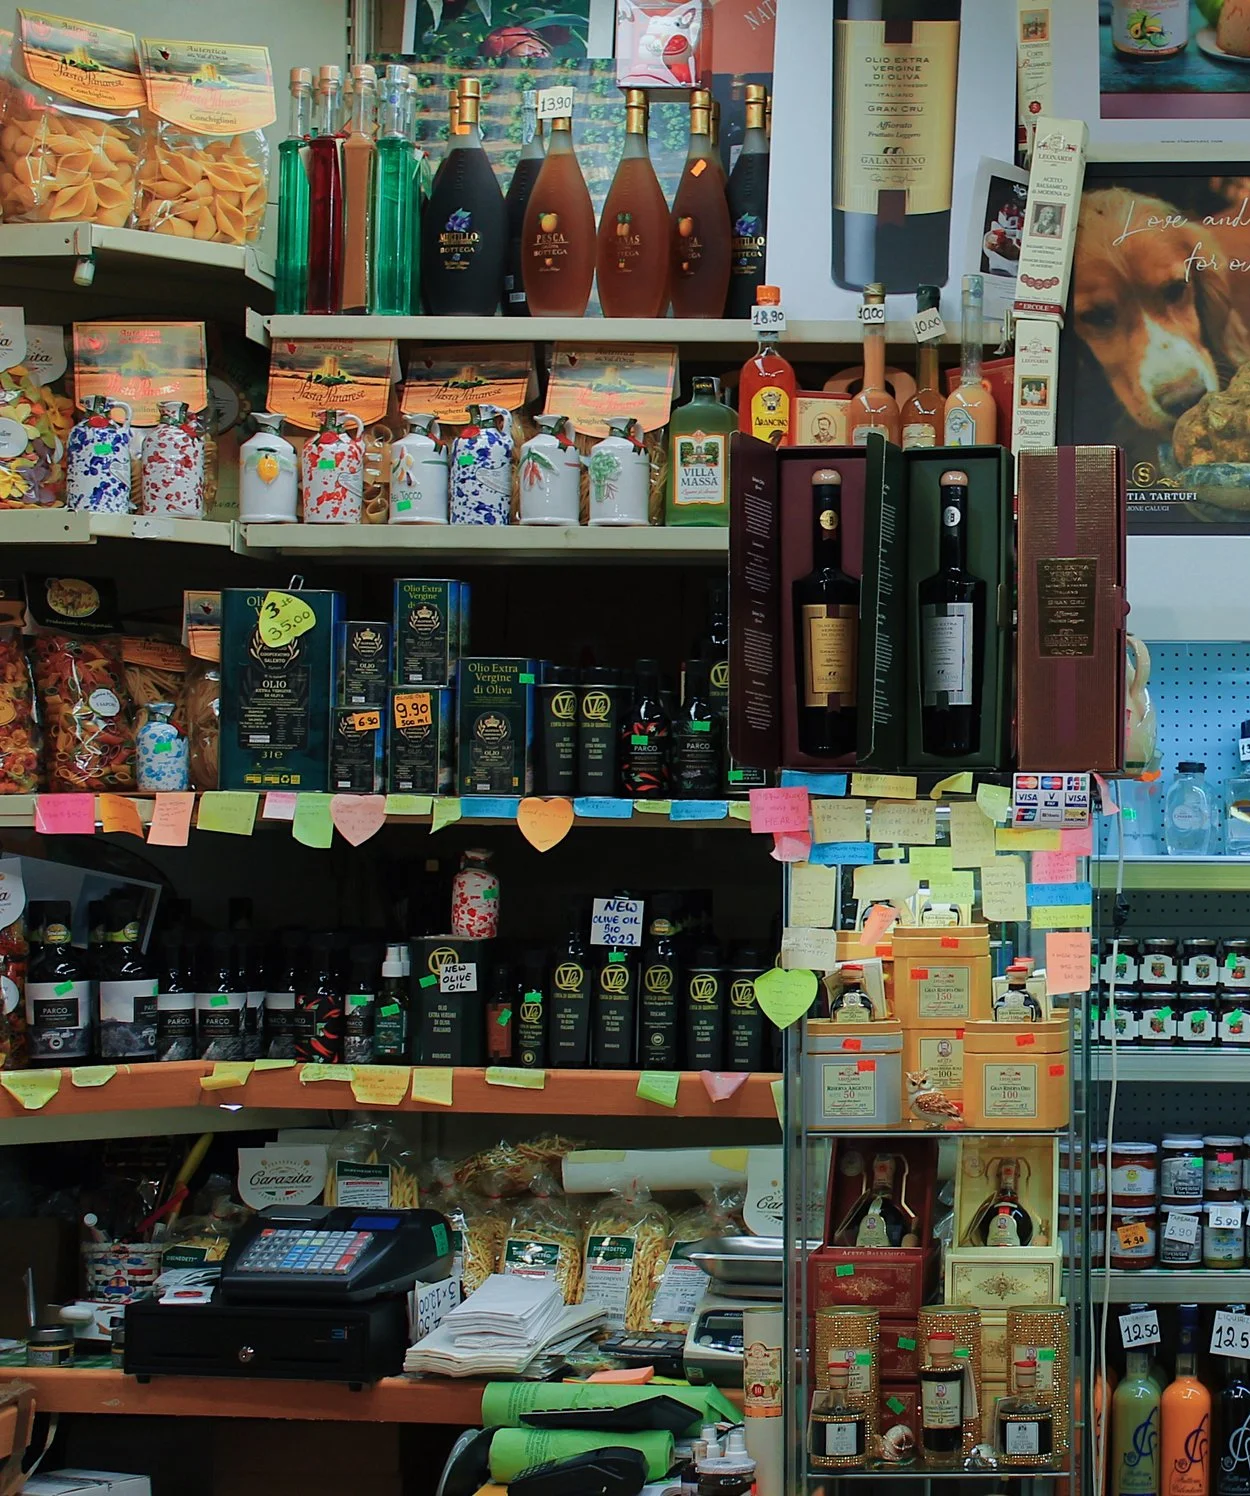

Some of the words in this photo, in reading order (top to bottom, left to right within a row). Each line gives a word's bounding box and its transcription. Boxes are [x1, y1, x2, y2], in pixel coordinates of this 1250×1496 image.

[189, 114, 237, 125] Conchiglioni
[876, 121, 913, 131] Affiorato
[860, 156, 926, 165] GALANTINO
[1112, 200, 1188, 247] Love
[536, 234, 565, 243] PESCA
[1184, 241, 1219, 283] for
[1022, 303, 1051, 312] ERCOLE
[753, 311, 785, 326] 18.90
[754, 417, 788, 427] ARANCINO
[683, 468, 715, 477] VILLA
[681, 477, 719, 487] MASSA
[1149, 492, 1197, 501] TARTUFI
[403, 585, 420, 593] Olio
[409, 592, 437, 600] Vergine
[265, 602, 281, 620] 3
[268, 610, 310, 641] 35.00
[468, 663, 490, 673] Olio
[492, 663, 518, 673] Extra
[475, 673, 512, 684] Vergine
[262, 680, 287, 688] OLIO
[473, 685, 484, 694] di
[486, 685, 513, 695] Oliva
[396, 702, 429, 719] 9.90
[358, 716, 378, 727] 6.90
[401, 719, 416, 727] 500
[1018, 793, 1038, 801] VISA
[1068, 794, 1087, 802] VISA
[603, 901, 638, 912] NEW
[592, 915, 619, 924] OLIVE
[622, 916, 641, 924] OIL
[604, 924, 621, 933] BIO
[444, 964, 467, 973] NEW
[442, 972, 472, 983] OLIVE
[447, 983, 467, 991] OIL
[938, 1070, 952, 1078] 100
[843, 1091, 856, 1099] 50
[1001, 1091, 1019, 1099] 100
[249, 1172, 314, 1186] Carazita
[1214, 1217, 1239, 1226] 5.90
[1168, 1226, 1193, 1237] 5.90
[1124, 1323, 1159, 1343] 12.50
